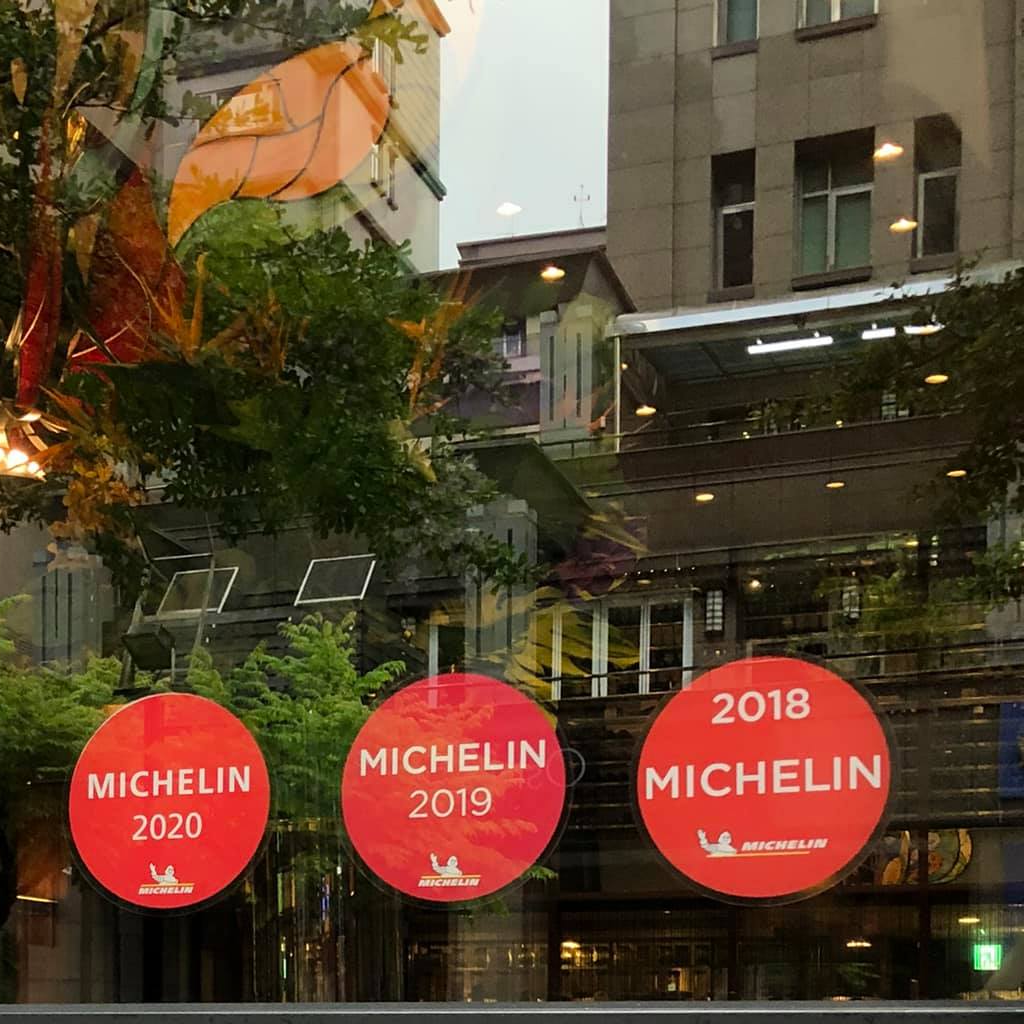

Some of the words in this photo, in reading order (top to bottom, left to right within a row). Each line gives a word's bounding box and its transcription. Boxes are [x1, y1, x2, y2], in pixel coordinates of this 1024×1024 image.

[711, 687, 811, 725] 2018
[360, 739, 547, 777] MICHELIN
[88, 765, 251, 800] MICHELIN
[645, 754, 881, 800] MICHELIN
[408, 787, 493, 819] 2019
[132, 811, 203, 841] 2020
[741, 837, 829, 852] MICHELIN
[138, 886, 195, 895] MICHELIN
[418, 878, 481, 888] MICHELIN
